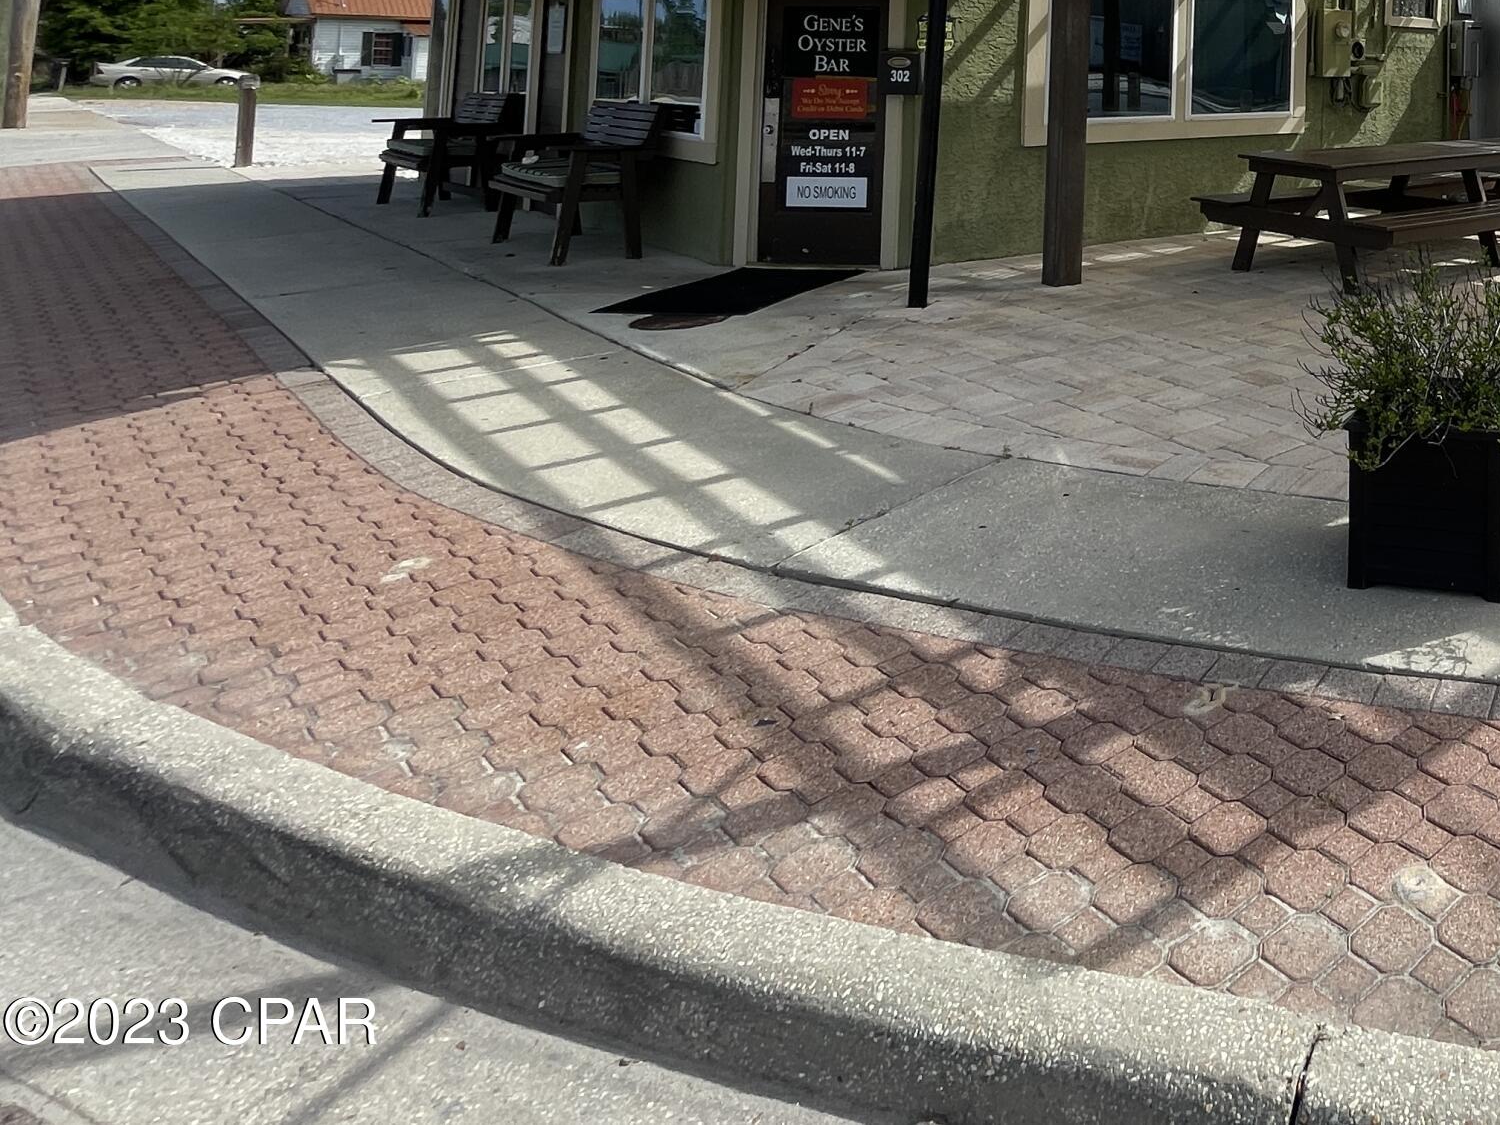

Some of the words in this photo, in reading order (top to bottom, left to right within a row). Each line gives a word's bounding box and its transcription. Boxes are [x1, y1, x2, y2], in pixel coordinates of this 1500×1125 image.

[803, 14, 864, 32] GENE'S
[797, 34, 868, 52] OYSTER
[813, 54, 850, 73] BAR
[890, 70, 910, 83] 302
[808, 129, 850, 141] OPEN
[791, 145, 843, 157] Wed-Thurs
[845, 146, 866, 157] 11-7
[800, 162, 832, 173] Fri-Sat
[834, 162, 856, 174] 11-8
[796, 185, 811, 199] NO
[813, 185, 857, 200] SMOKING
